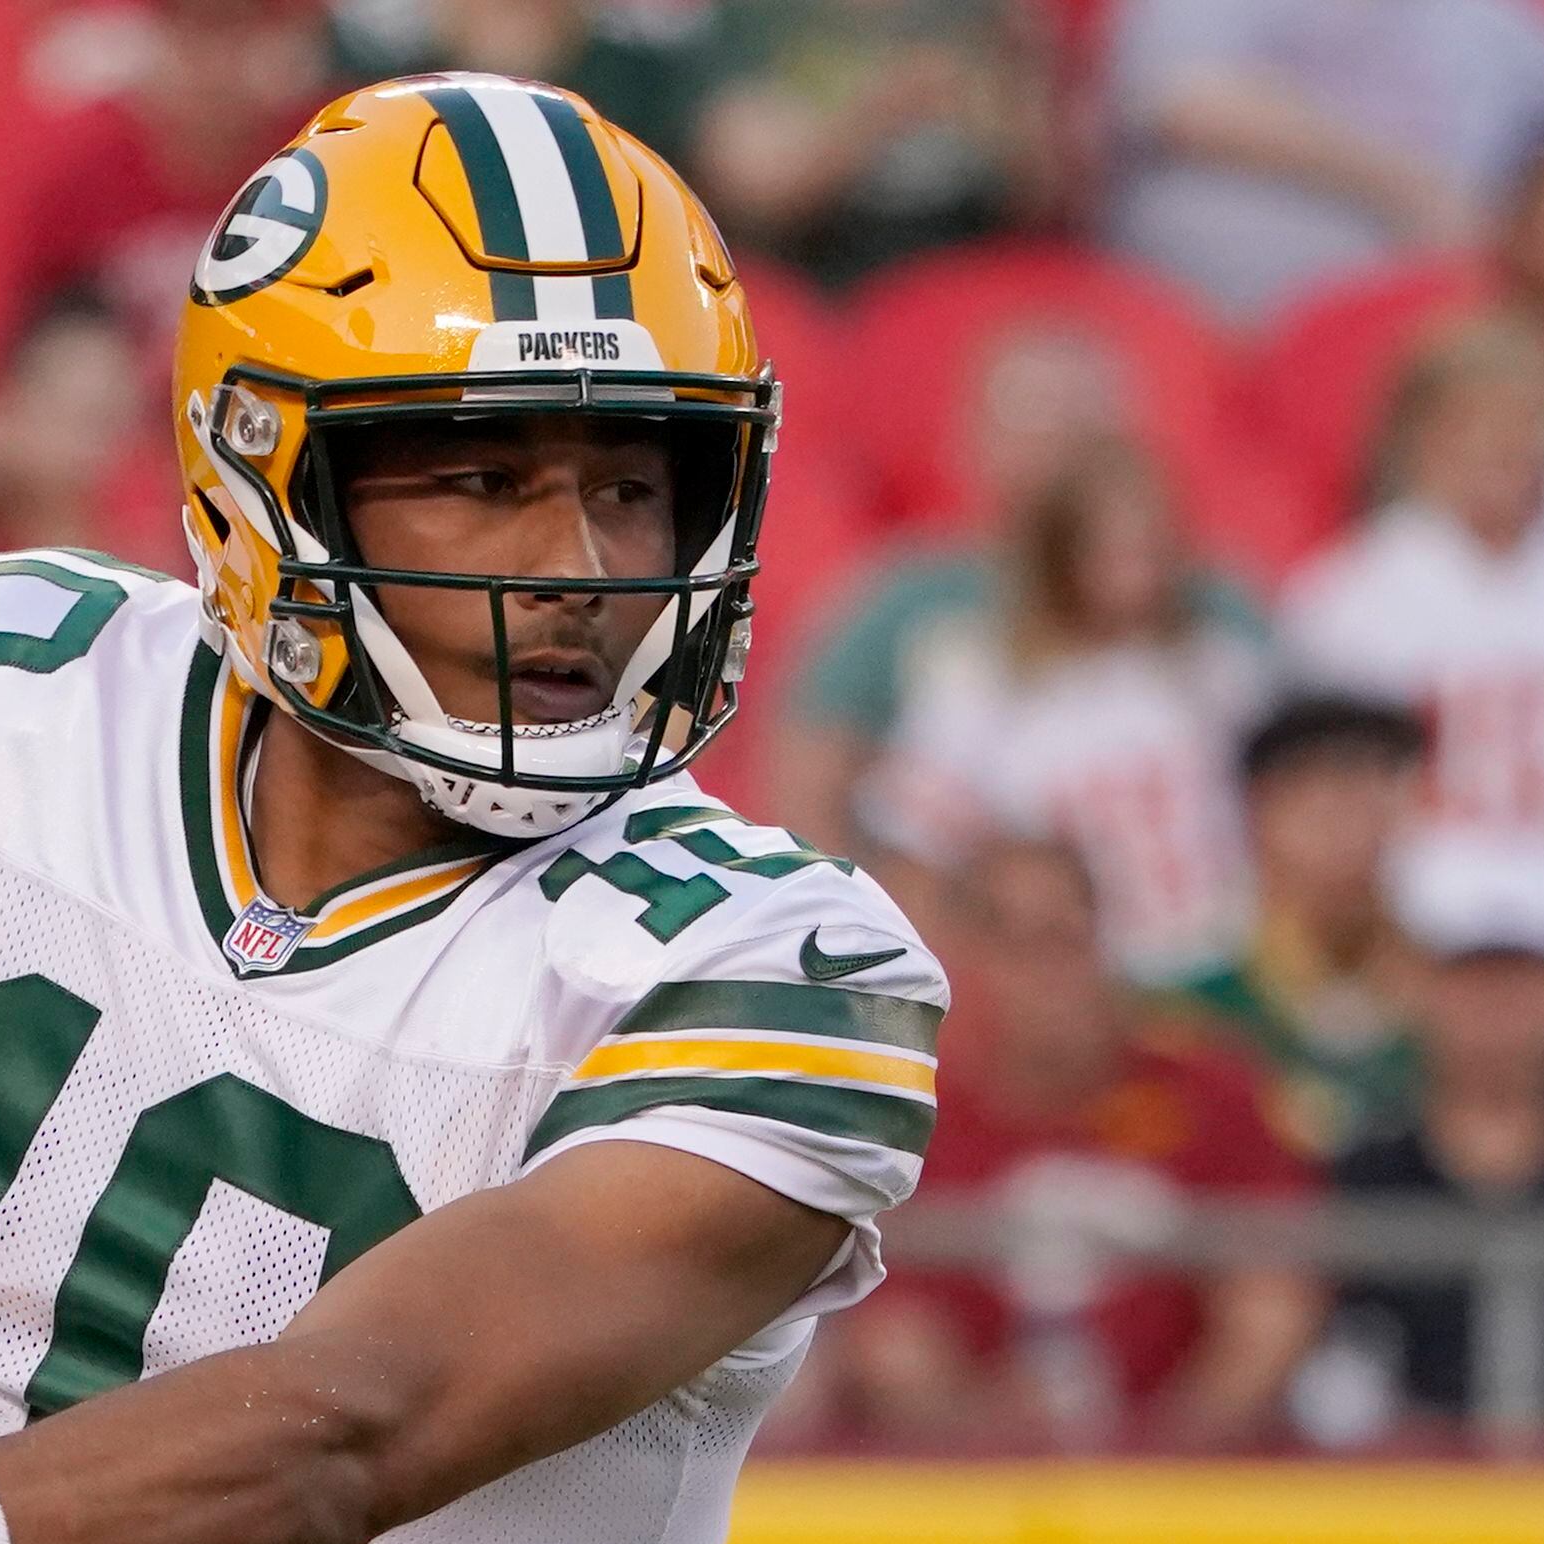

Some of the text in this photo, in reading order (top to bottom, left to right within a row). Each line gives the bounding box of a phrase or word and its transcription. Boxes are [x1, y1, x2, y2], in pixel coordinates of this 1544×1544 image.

[192, 152, 322, 299] G
[518, 331, 621, 361] PACKERS
[233, 921, 284, 960] NFL
